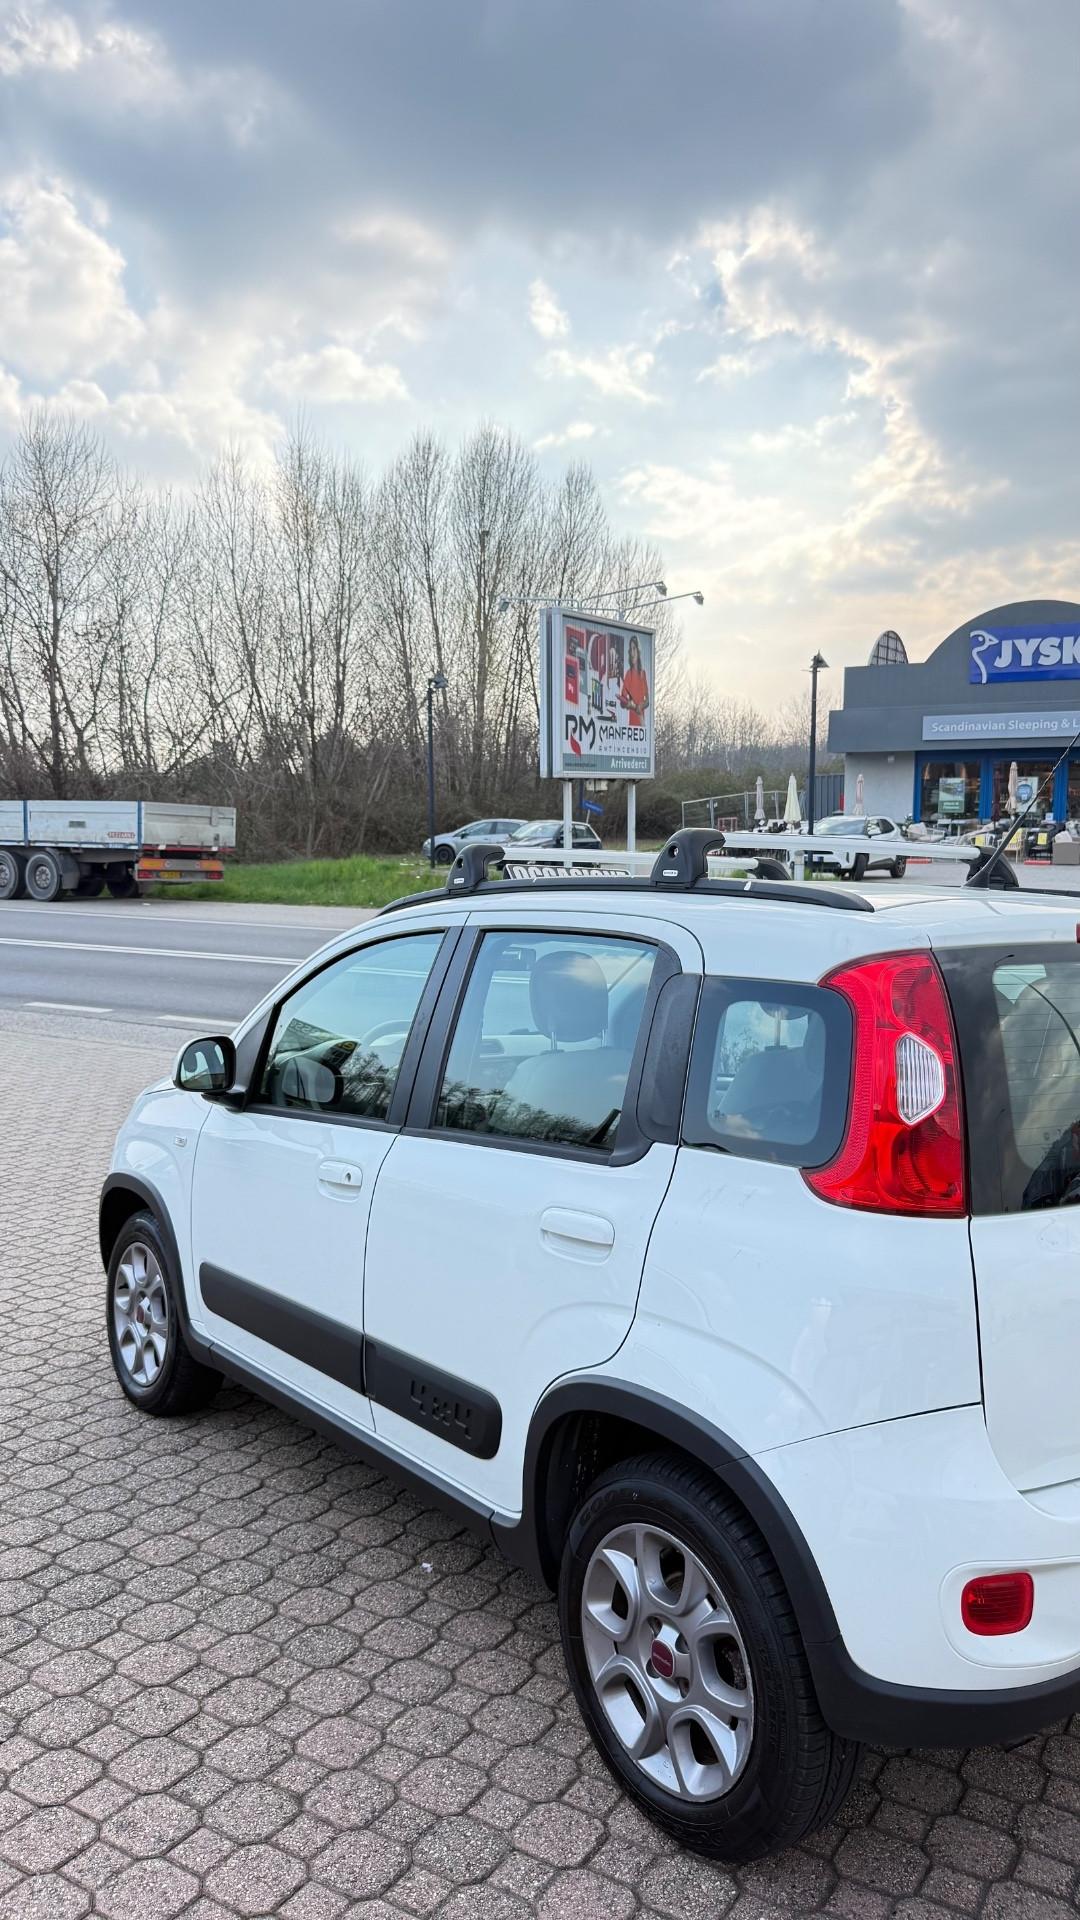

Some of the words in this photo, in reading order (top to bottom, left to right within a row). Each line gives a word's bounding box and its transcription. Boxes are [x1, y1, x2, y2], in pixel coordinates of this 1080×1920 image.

[994, 636, 1080, 668] JYSK
[599, 725, 647, 742] MANFREDI
[931, 721, 1006, 733] Scandinavian
[1007, 718, 1058, 731] Sleeping
[1060, 718, 1071, 729] &
[610, 757, 648, 769] Arrivederci
